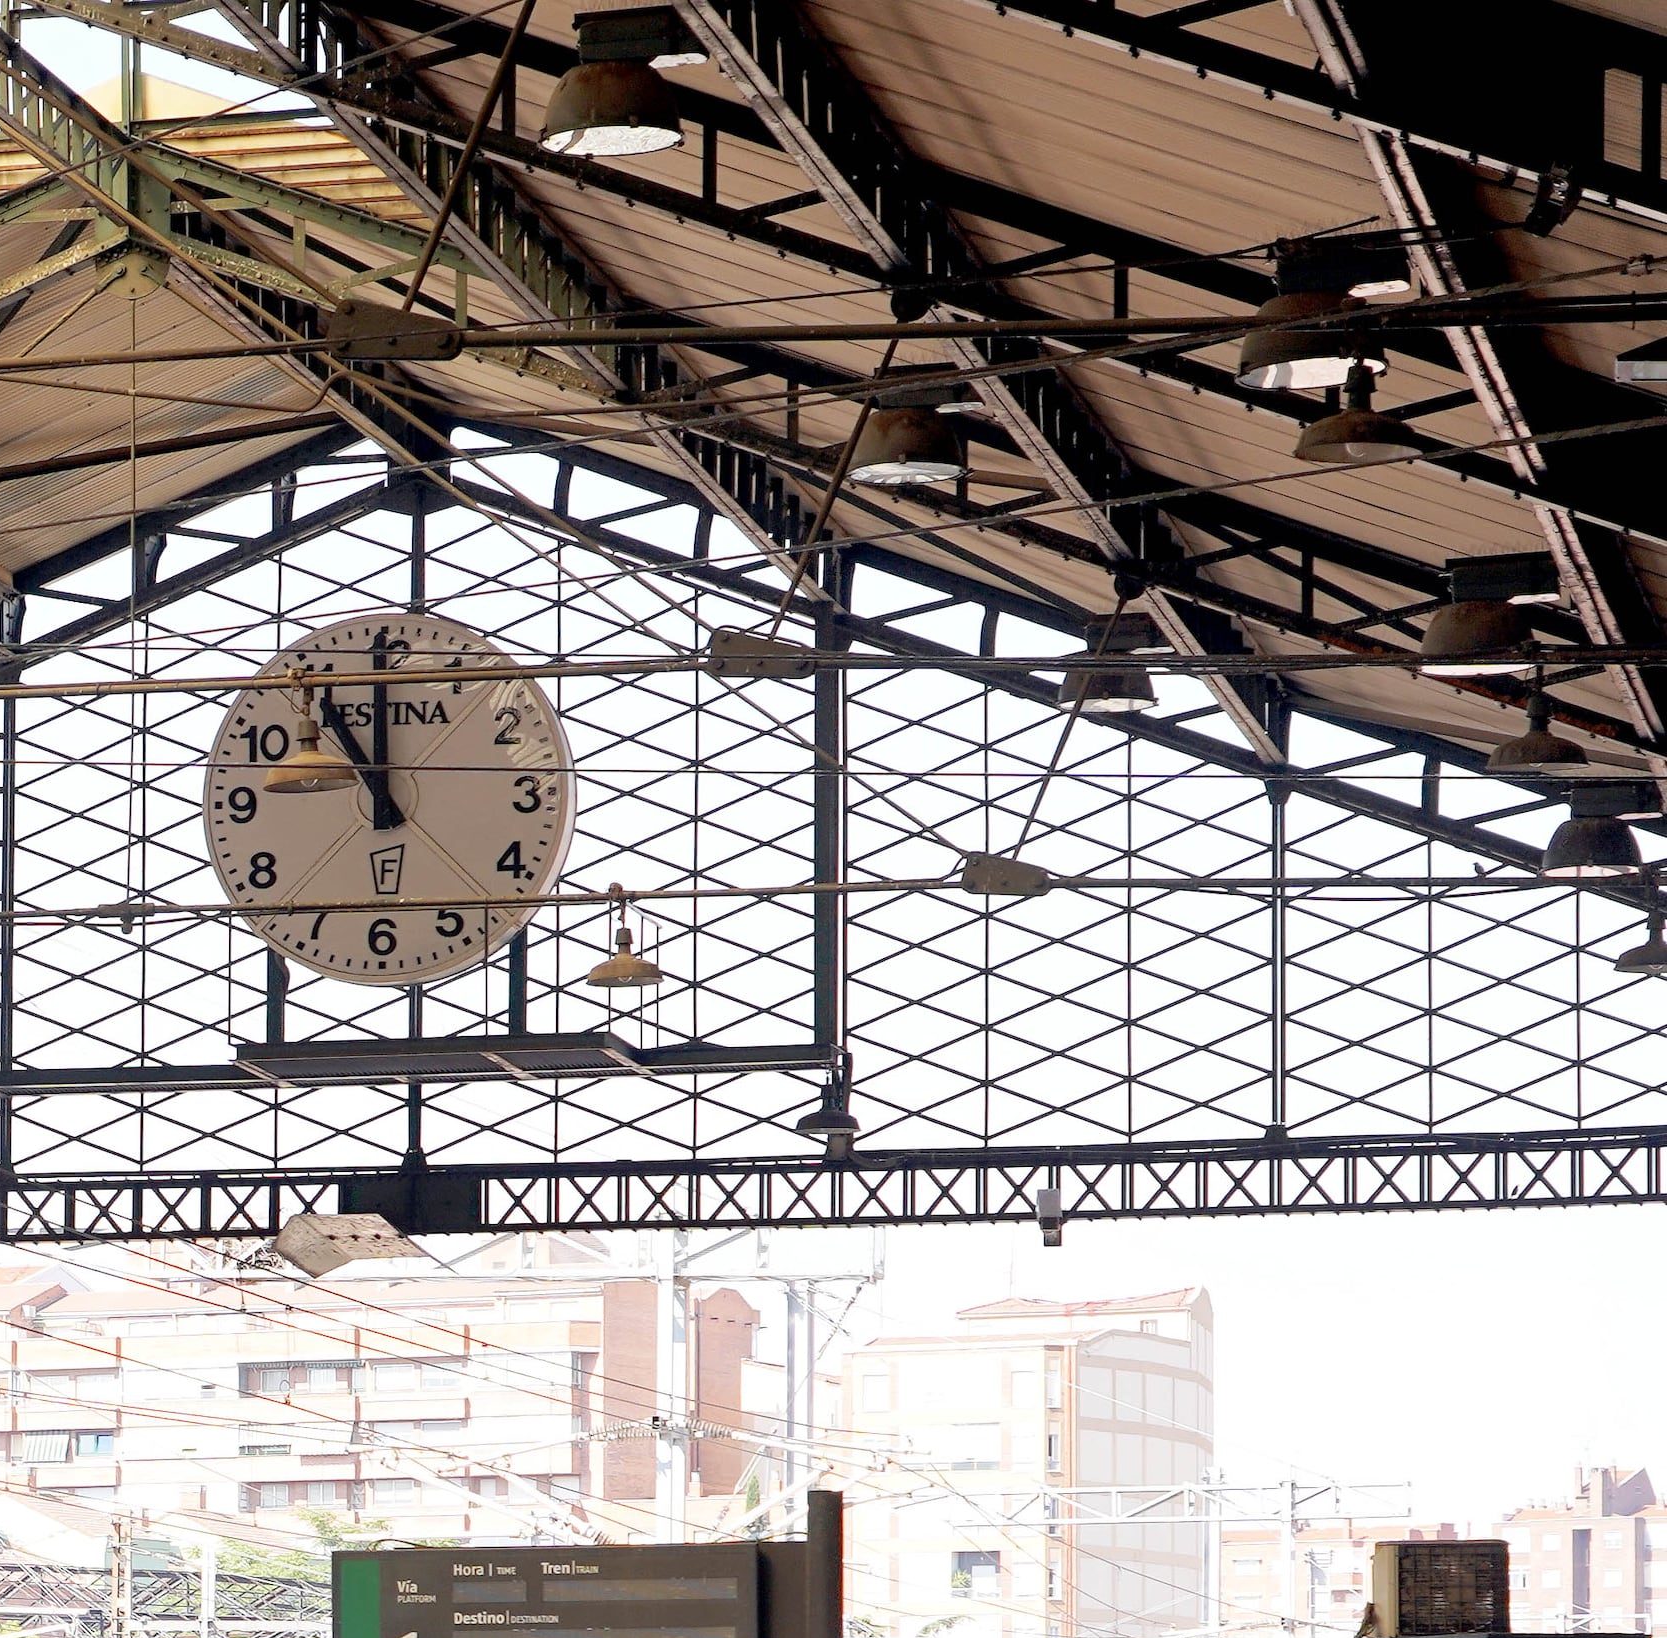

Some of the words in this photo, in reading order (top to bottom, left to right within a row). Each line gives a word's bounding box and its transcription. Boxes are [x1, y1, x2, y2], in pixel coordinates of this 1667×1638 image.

[494, 706, 522, 745] 2
[240, 724, 289, 763] 10
[228, 786, 257, 824] 9
[512, 775, 542, 814] 3
[248, 851, 278, 889] 8
[380, 859, 398, 885] F
[496, 840, 527, 879] 4
[368, 918, 397, 956] 6
[435, 909, 464, 938] 5
[453, 1563, 484, 1576] Hora
[496, 1566, 517, 1575] TIME
[541, 1562, 571, 1575] Tren
[575, 1565, 599, 1574] TRAIN
[396, 1580, 418, 1593] Vía
[397, 1595, 437, 1604] PLATFORM
[453, 1611, 506, 1625] Destino
[510, 1615, 559, 1624] DESTINATION
